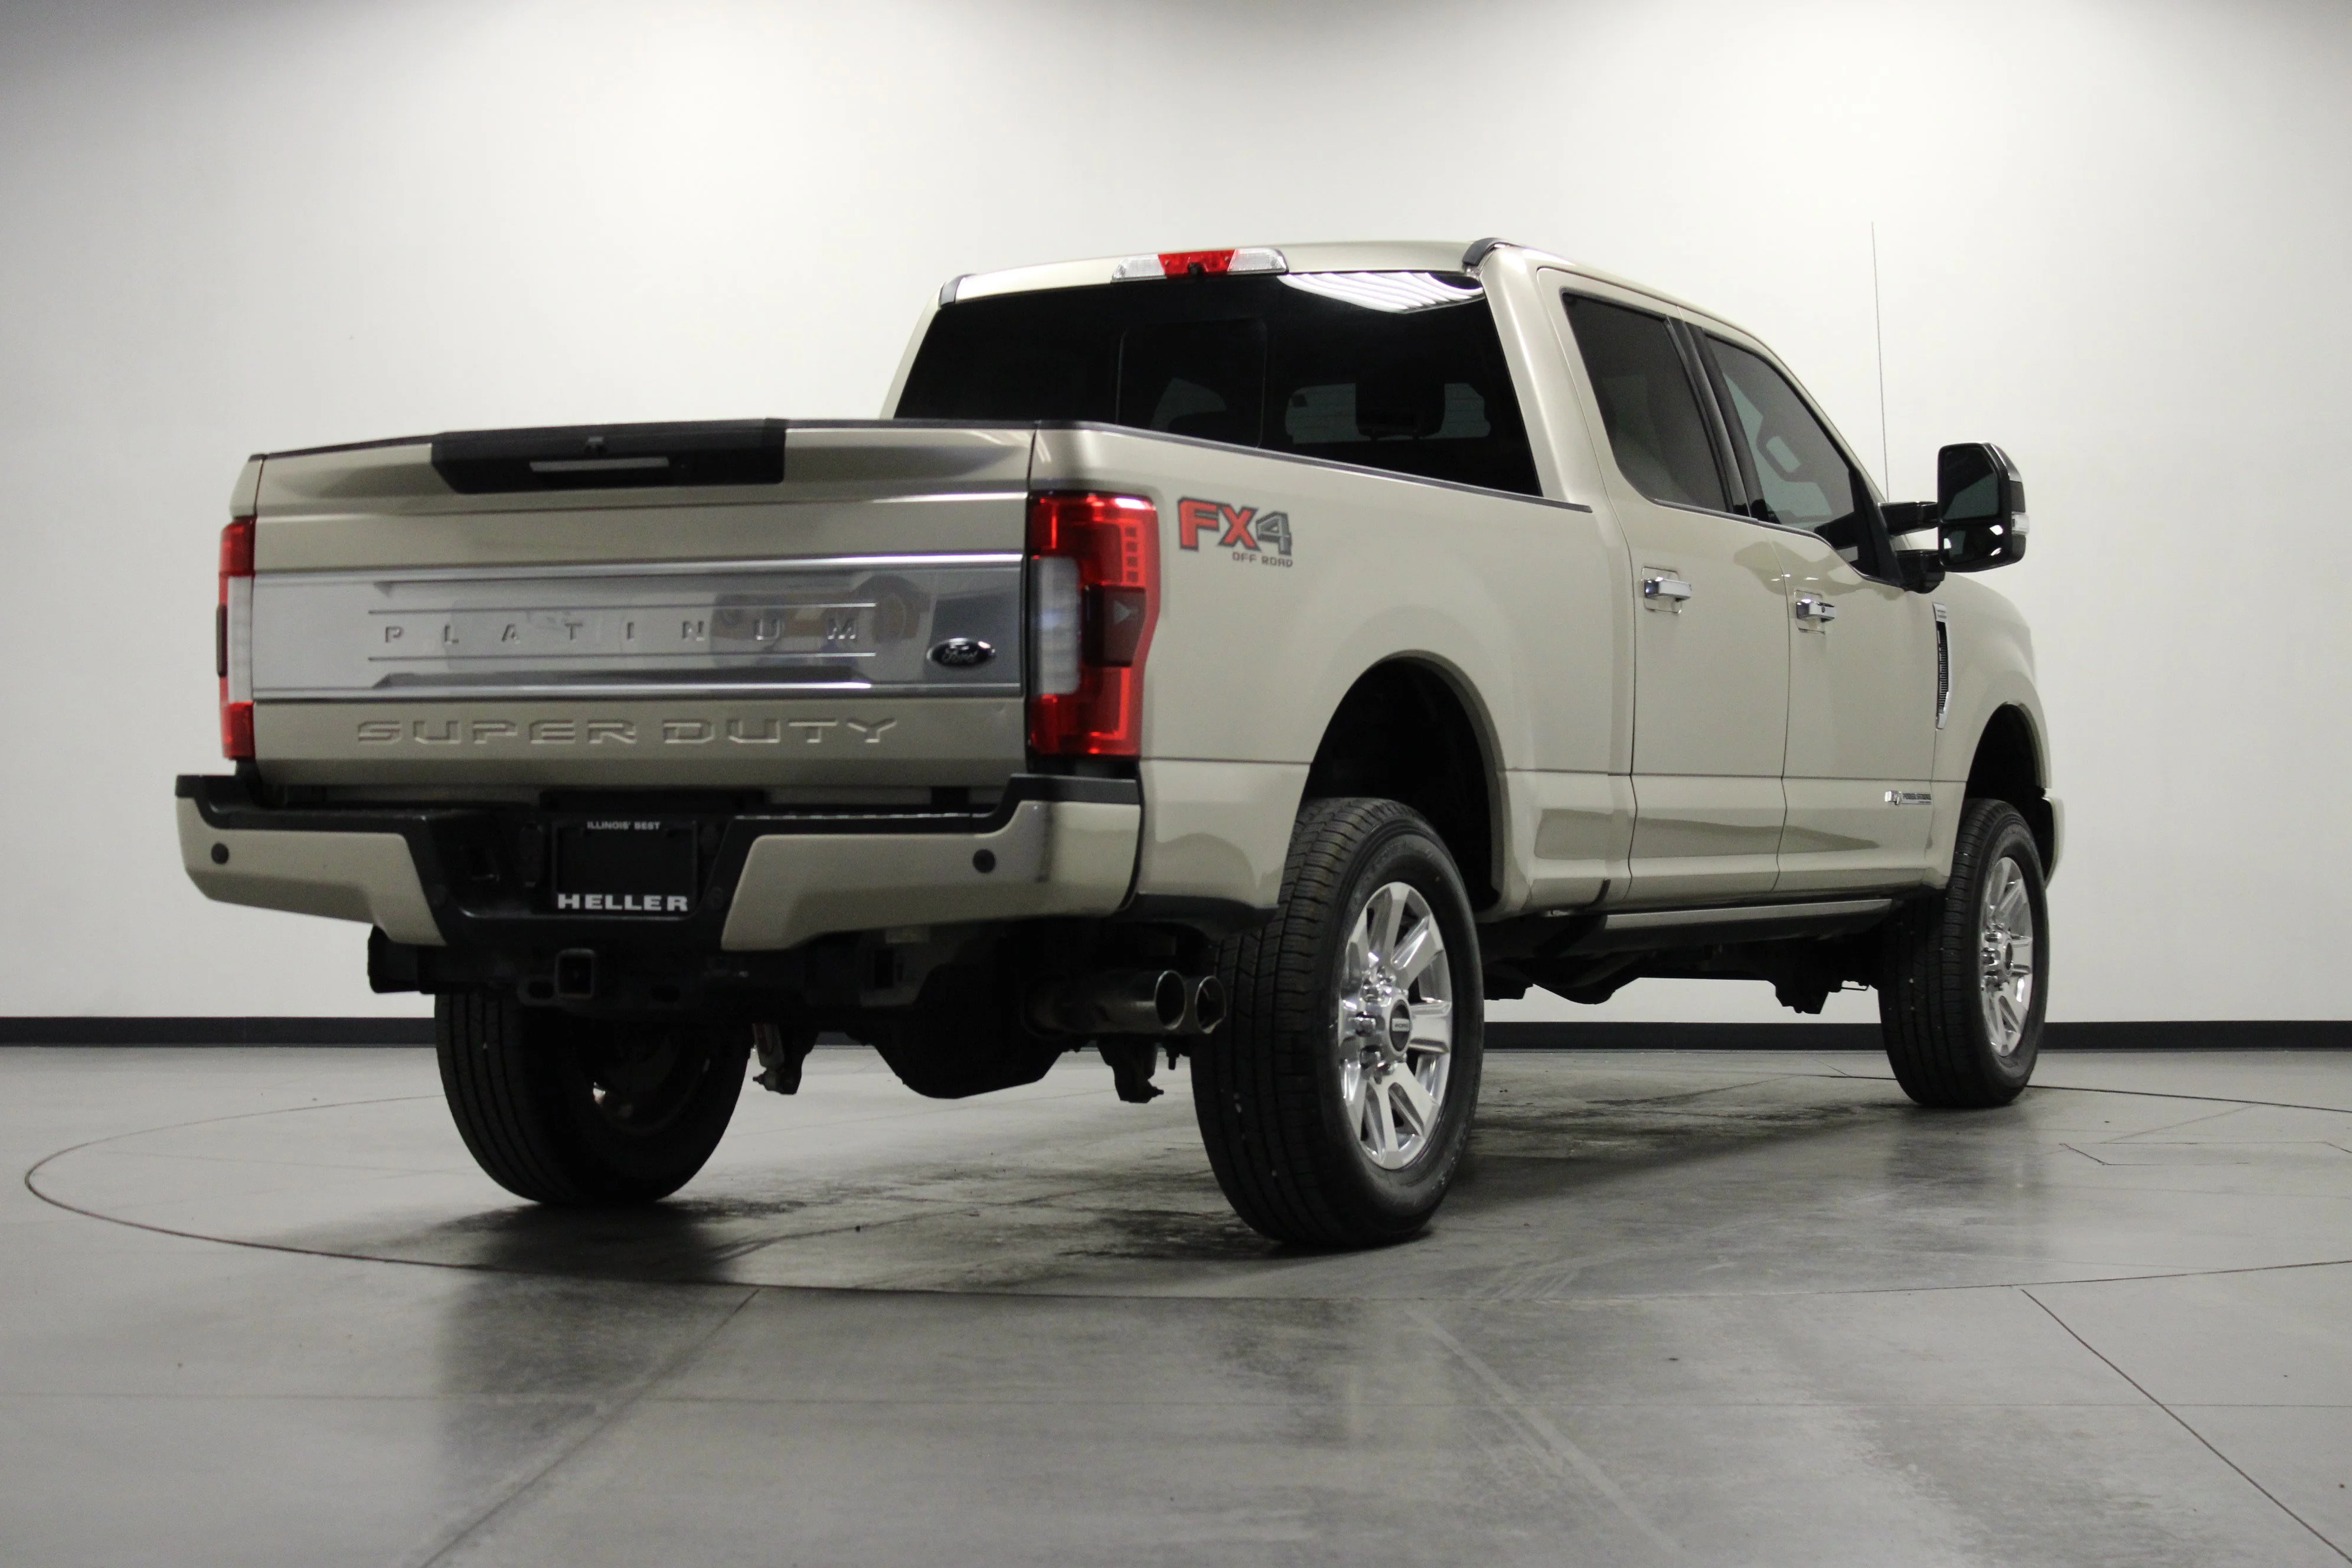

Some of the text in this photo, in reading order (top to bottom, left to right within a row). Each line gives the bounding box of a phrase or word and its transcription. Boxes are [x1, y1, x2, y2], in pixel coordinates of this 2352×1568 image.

[1177, 496, 1292, 556] FX4
[1232, 551, 1293, 568] OFF ROAD
[384, 618, 857, 643] PLATINUM
[358, 717, 899, 745] SUPER DUTY
[634, 821, 661, 830] BEST
[557, 893, 688, 912] HELLER
